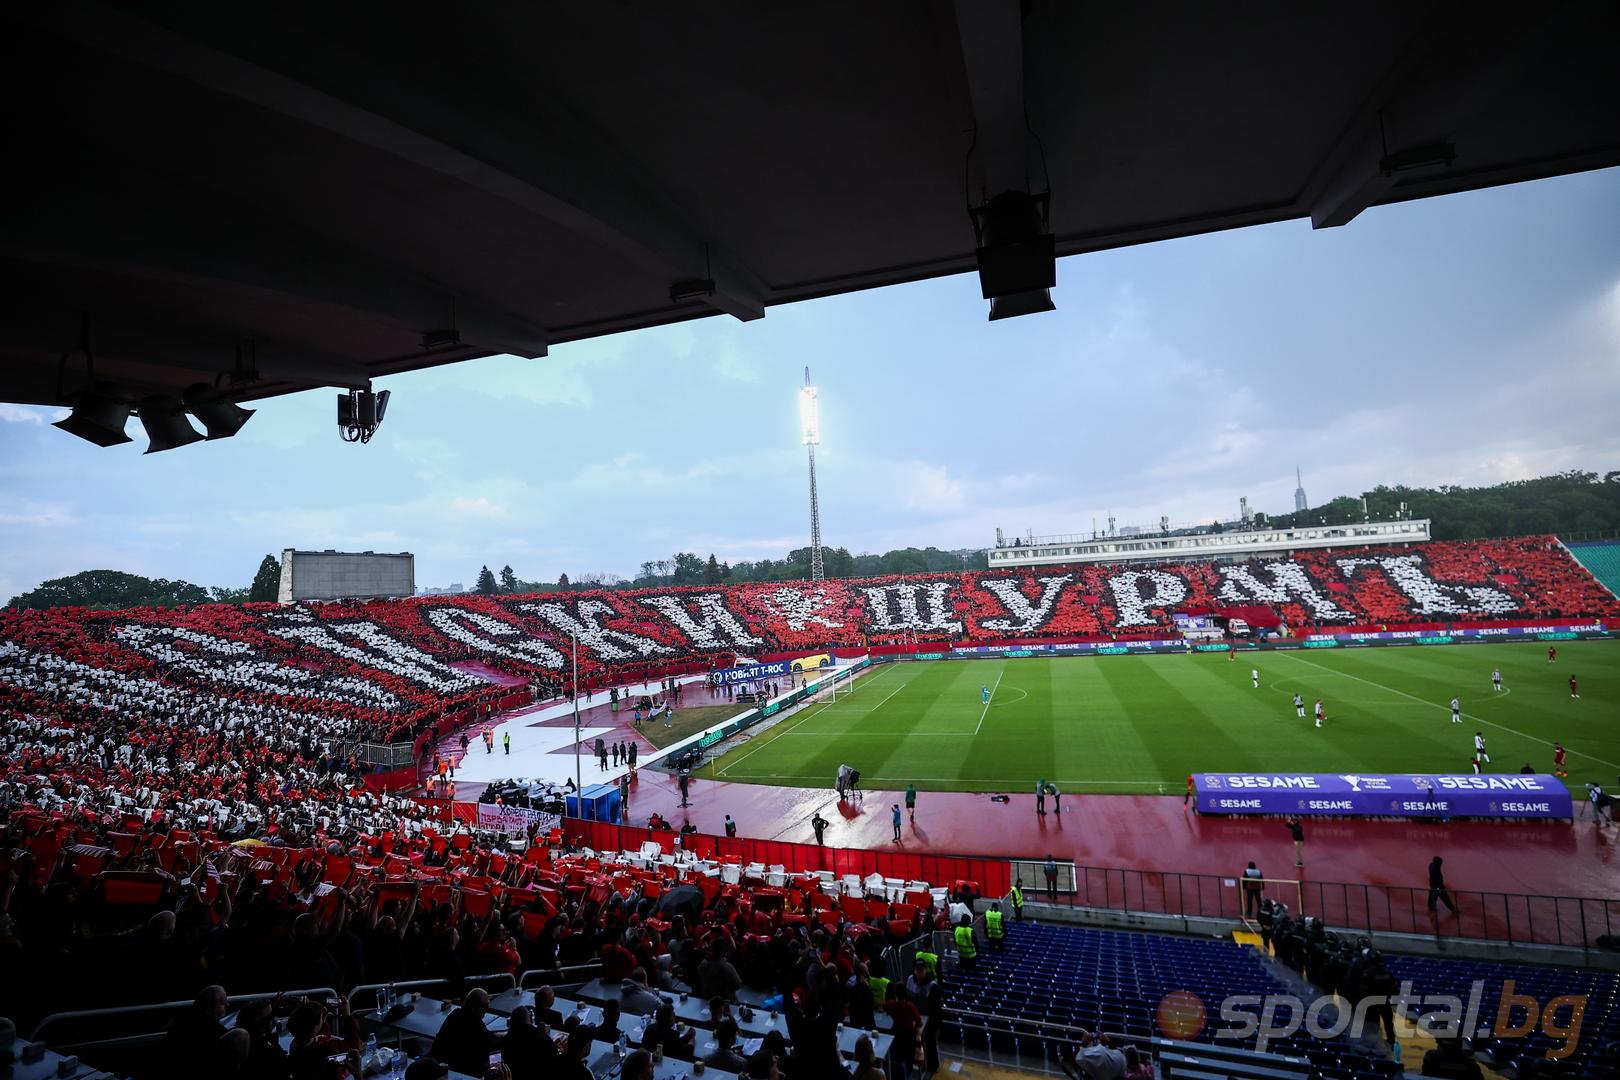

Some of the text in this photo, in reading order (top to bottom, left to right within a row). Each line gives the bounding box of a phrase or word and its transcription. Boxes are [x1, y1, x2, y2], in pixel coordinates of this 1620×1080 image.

[761, 663, 784, 675] T-ROC
[1220, 799, 1550, 812] SESAME SESAME SESAME SESAME
